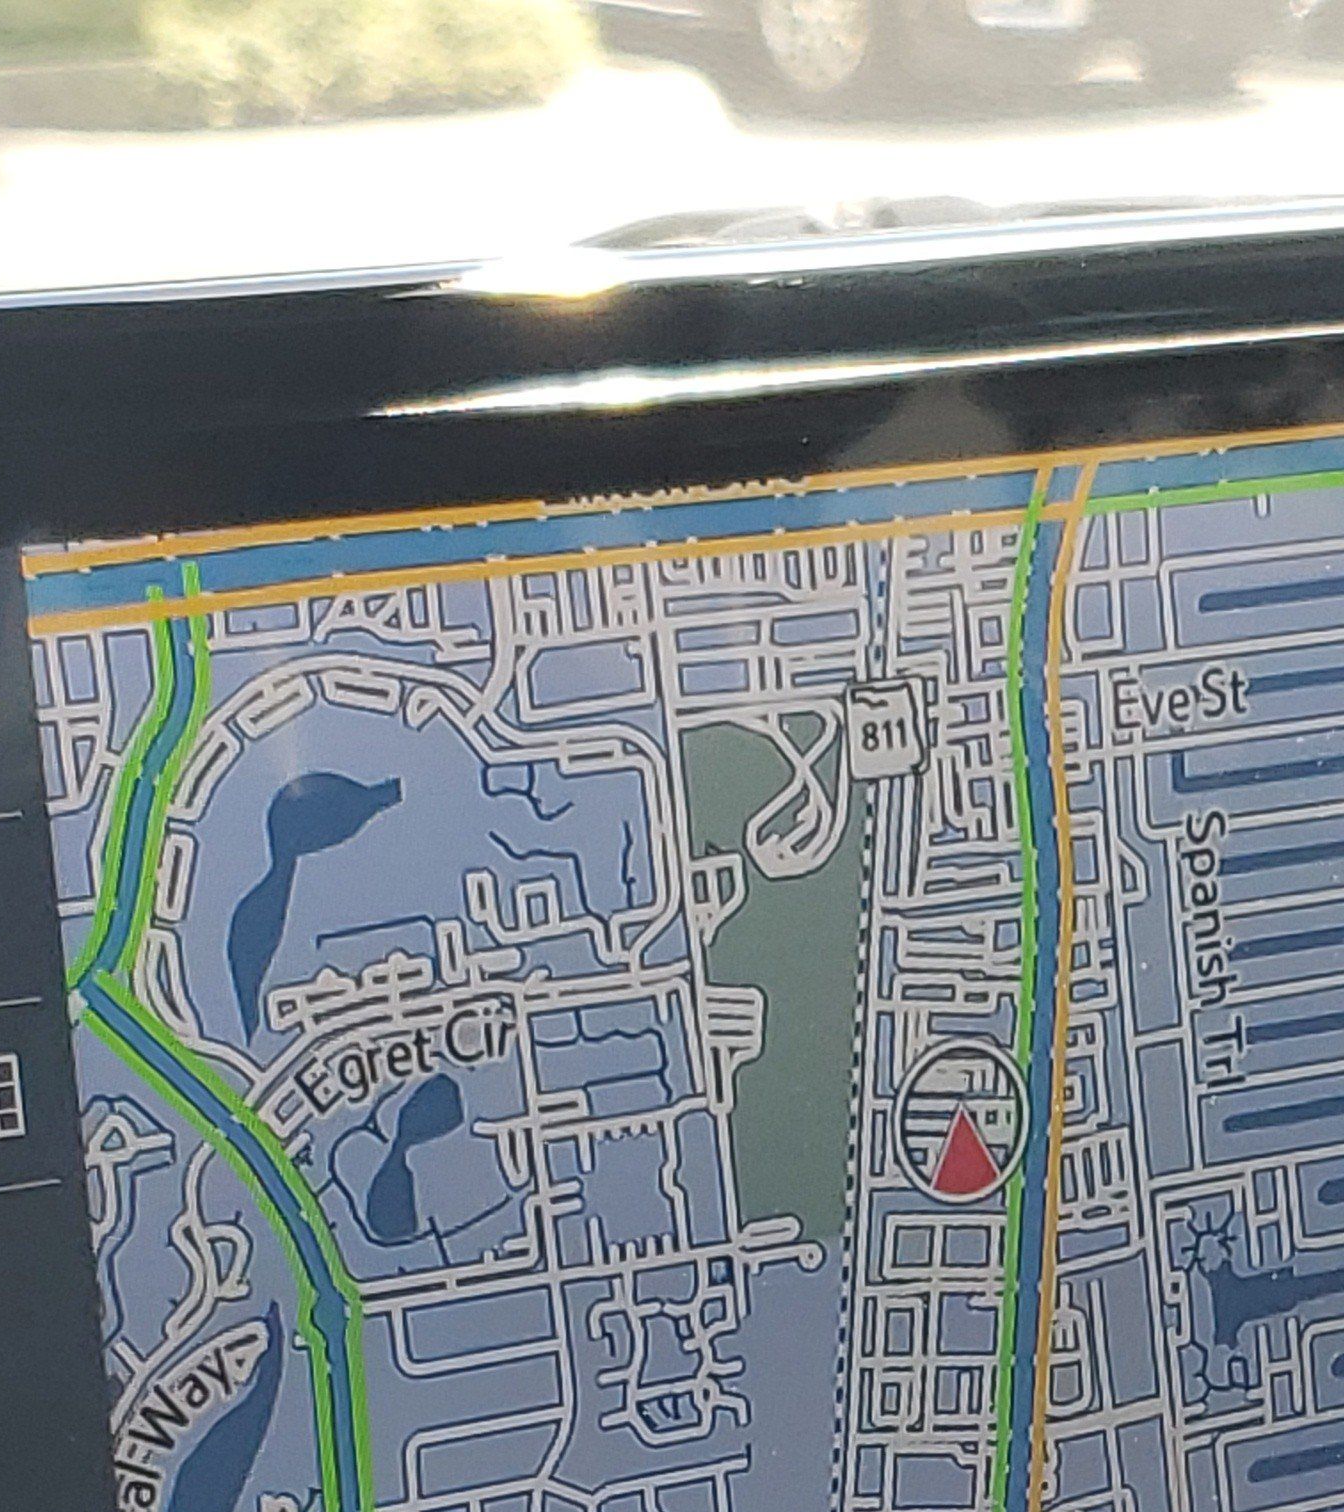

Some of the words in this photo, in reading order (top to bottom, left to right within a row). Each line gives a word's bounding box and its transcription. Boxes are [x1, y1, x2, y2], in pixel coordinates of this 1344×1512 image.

[862, 720, 907, 752] 811
[1113, 675, 1199, 731] Eve
[1201, 666, 1248, 718] St
[1186, 811, 1232, 1008] Spanish
[294, 1033, 434, 1113] Egret
[445, 1007, 516, 1063] Cir
[1205, 1015, 1244, 1089] Trl
[128, 1348, 232, 1449] Way
